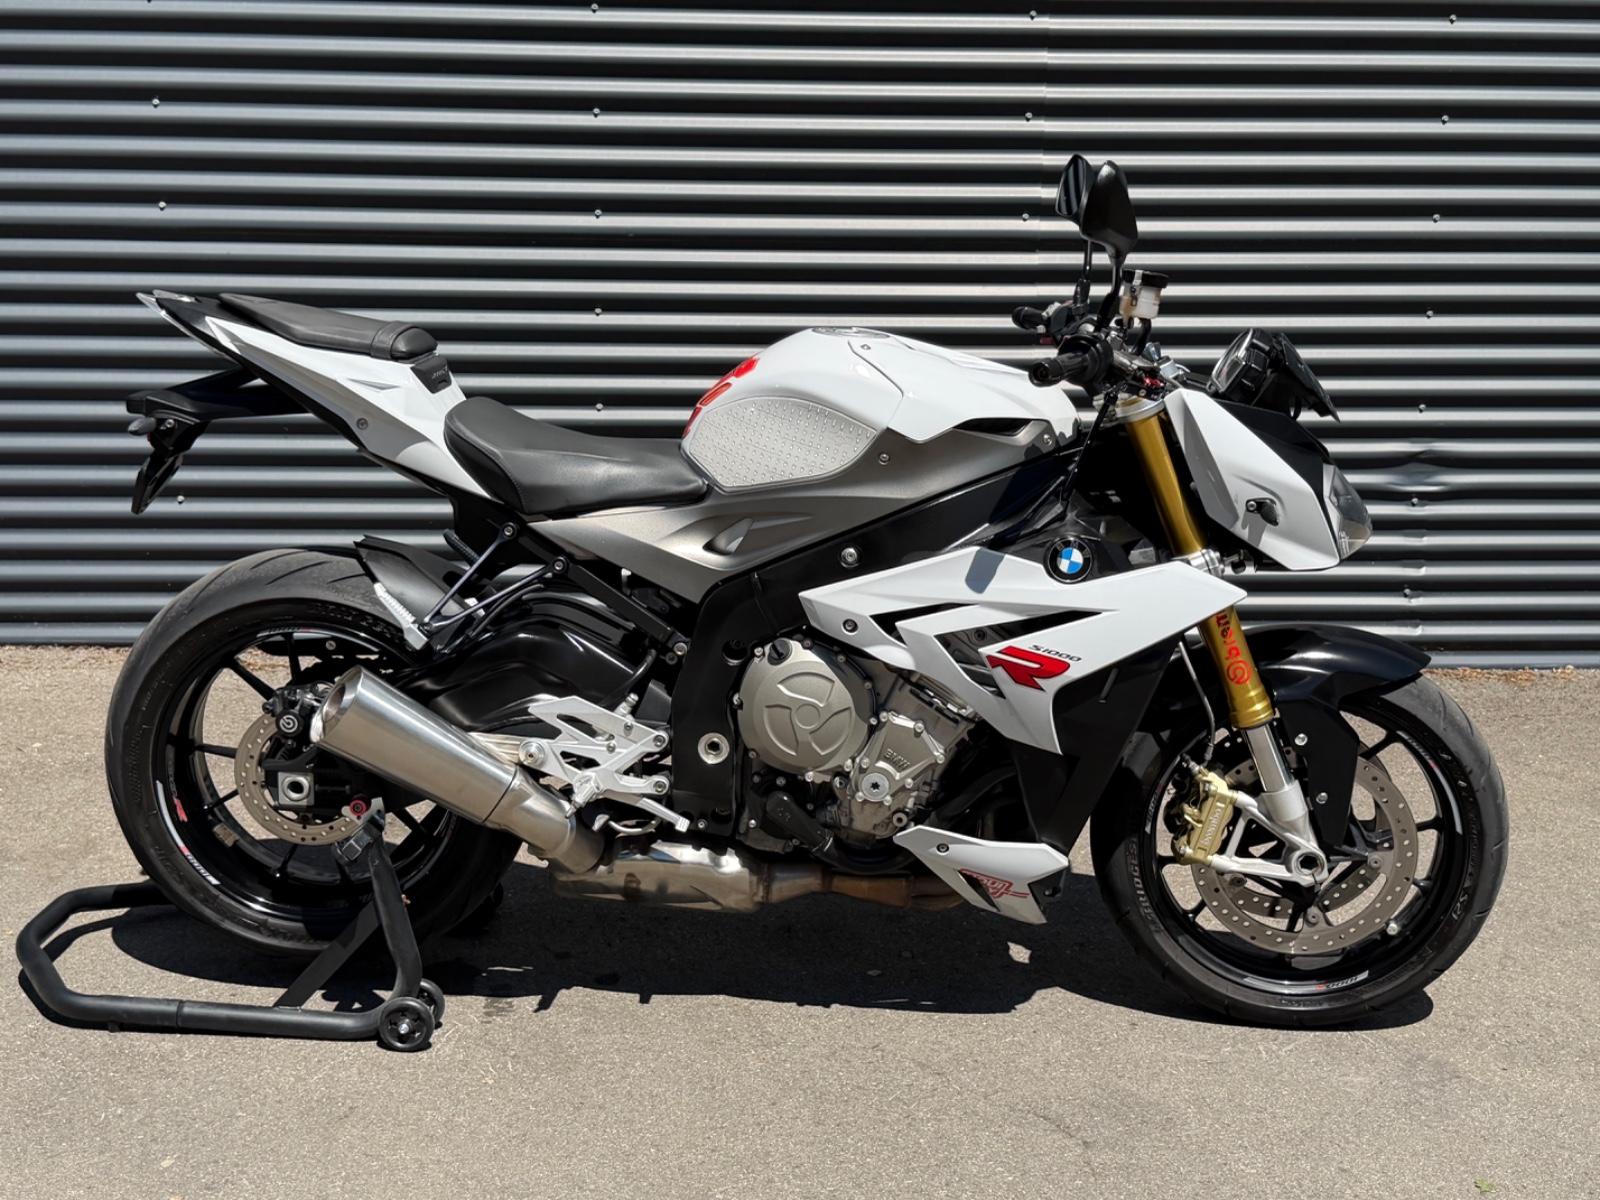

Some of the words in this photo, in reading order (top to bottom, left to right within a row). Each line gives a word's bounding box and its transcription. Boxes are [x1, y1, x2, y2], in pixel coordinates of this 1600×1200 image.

[1029, 644, 1082, 662] S1000
[986, 645, 1071, 692] R
[883, 748, 911, 771] BMW
